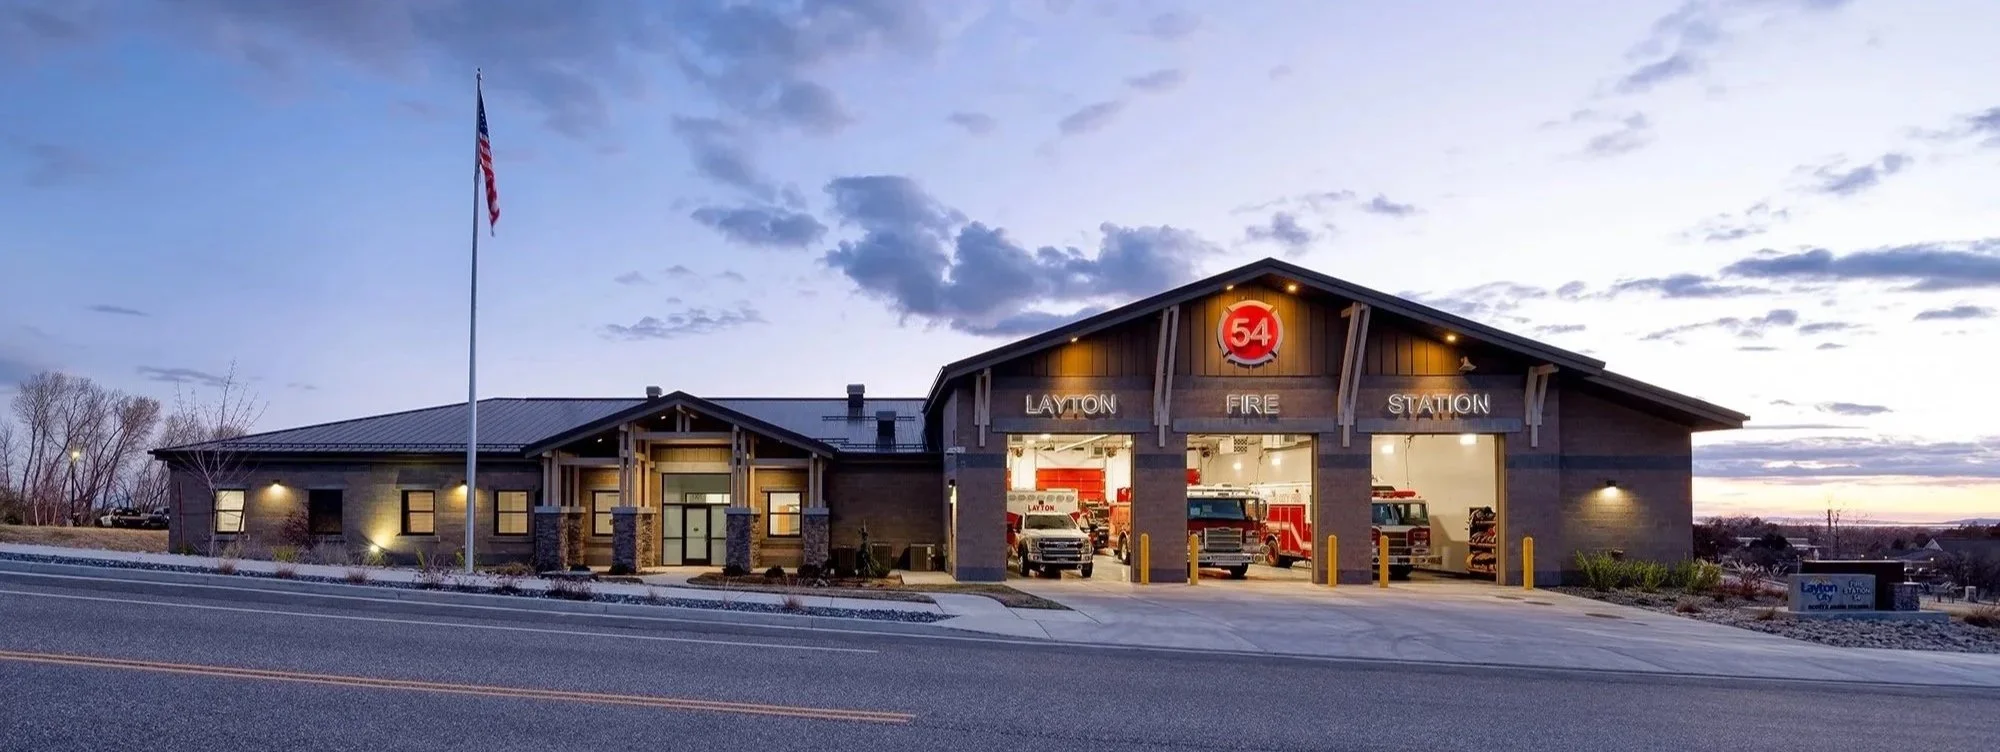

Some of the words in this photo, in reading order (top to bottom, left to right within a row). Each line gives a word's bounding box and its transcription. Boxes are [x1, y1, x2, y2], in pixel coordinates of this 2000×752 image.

[1230, 317, 1272, 347] 54
[1026, 394, 1117, 414] LAYTON
[1226, 394, 1280, 414] FIRE
[1388, 393, 1490, 415] STATION
[1801, 582, 1838, 596] Layton
[1816, 593, 1833, 602] City
